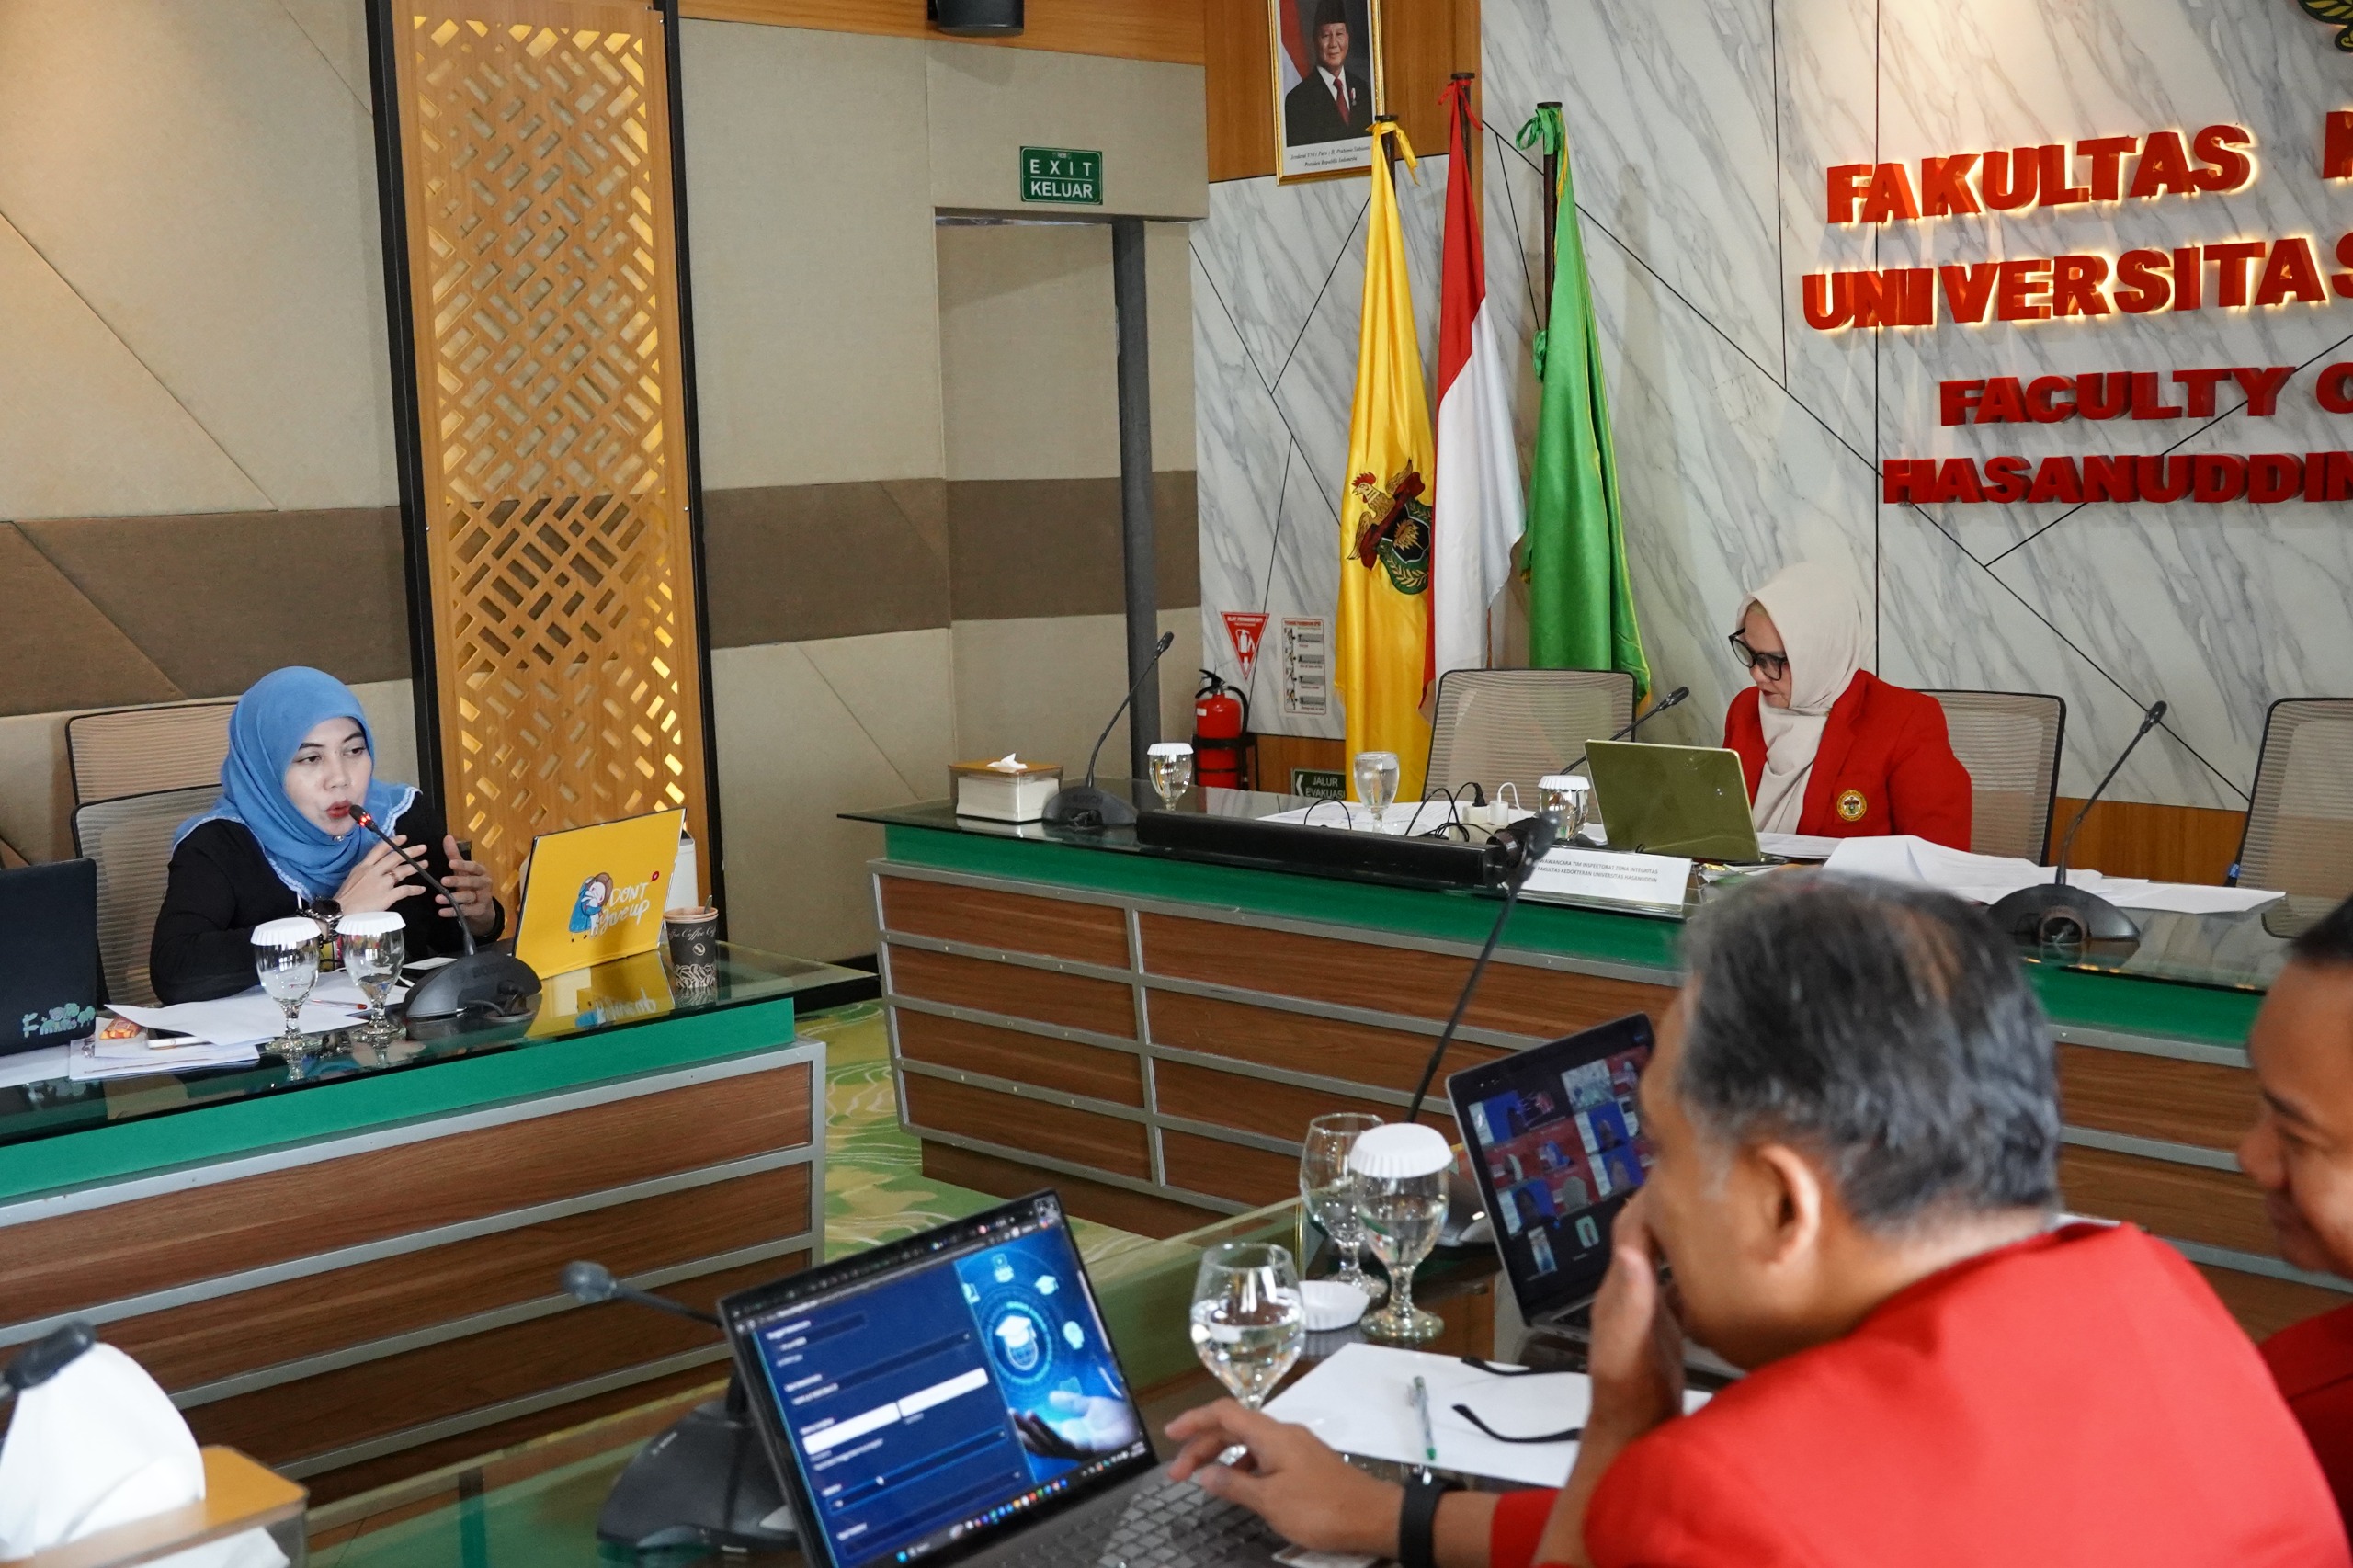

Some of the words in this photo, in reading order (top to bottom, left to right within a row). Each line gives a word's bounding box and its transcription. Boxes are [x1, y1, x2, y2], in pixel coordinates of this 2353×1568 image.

[1030, 159, 1092, 176] EXIT
[1827, 124, 2252, 224] FAKULTAS
[1031, 181, 1093, 198] KELUAR
[1940, 367, 2296, 426] FACULTY
[1313, 776, 1338, 787] JALUR
[1305, 787, 1346, 799] EVAKUASI
[1583, 862, 1614, 870] INSPEKTORAT
[1593, 871, 1623, 880] UNIVERSITAS
